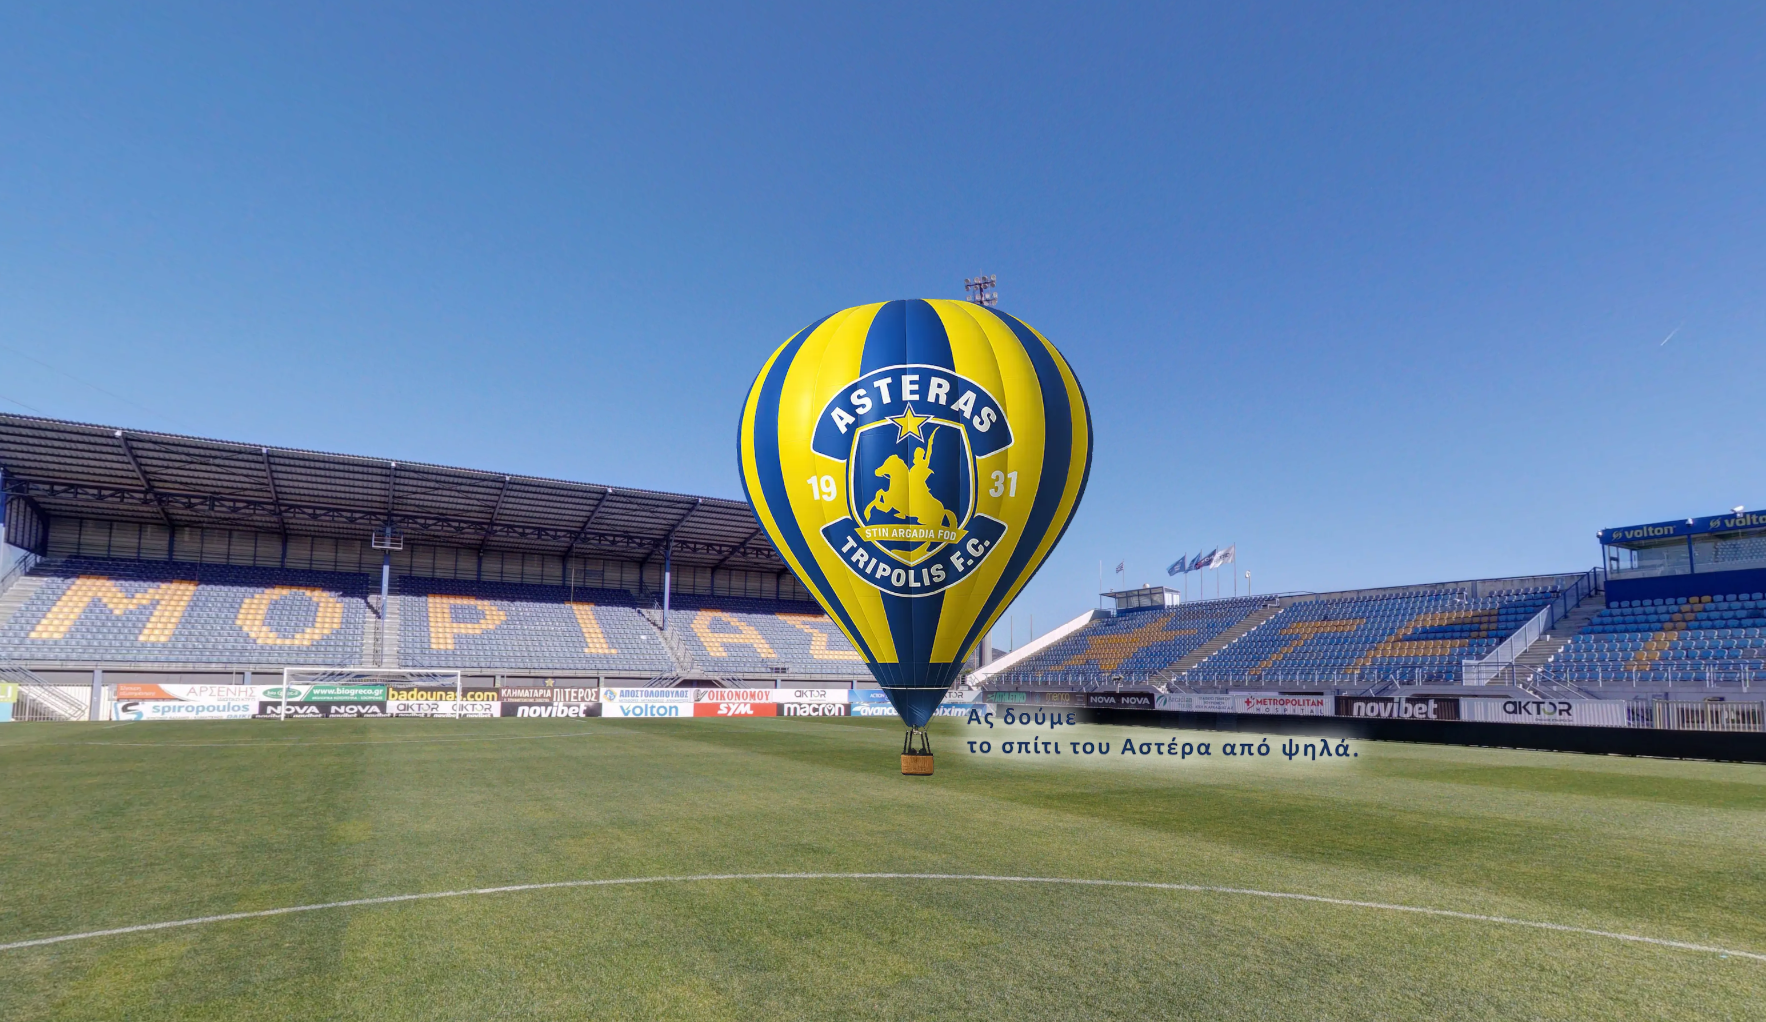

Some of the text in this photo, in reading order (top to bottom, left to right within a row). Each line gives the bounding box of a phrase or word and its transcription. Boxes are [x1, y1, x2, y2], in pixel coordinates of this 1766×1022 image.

[831, 374, 996, 434] ASTERAS
[807, 475, 837, 501] 19
[989, 471, 1018, 498] 31
[865, 528, 957, 540] STIN ARGADIA FOD
[1625, 525, 1674, 539] volton
[840, 535, 991, 588] TRIPOLIS F.C.
[186, 686, 257, 697] ΑΡΣΕΝΗΣ
[313, 687, 383, 695] www.biogreco.gr
[501, 689, 552, 697] ΚΛΗΜΑΤΑΡΙΑ
[553, 688, 598, 702] ΠΙΤΕΡΟΣ
[619, 690, 688, 698] ΑΠΟΣΤΟΛΟΠΟΥΛΟΣ
[1090, 696, 1116, 704] NOVA
[1121, 697, 1150, 705] NOVA
[1256, 698, 1324, 707] METROPOLITAN
[152, 702, 250, 716] spiropoulos
[266, 705, 381, 714] NOVA NOVA
[517, 702, 587, 717] novibet
[619, 704, 679, 716] volton
[784, 703, 845, 716] macron
[1256, 707, 1325, 715] HOSPITAL
[1353, 697, 1438, 718] novibet
